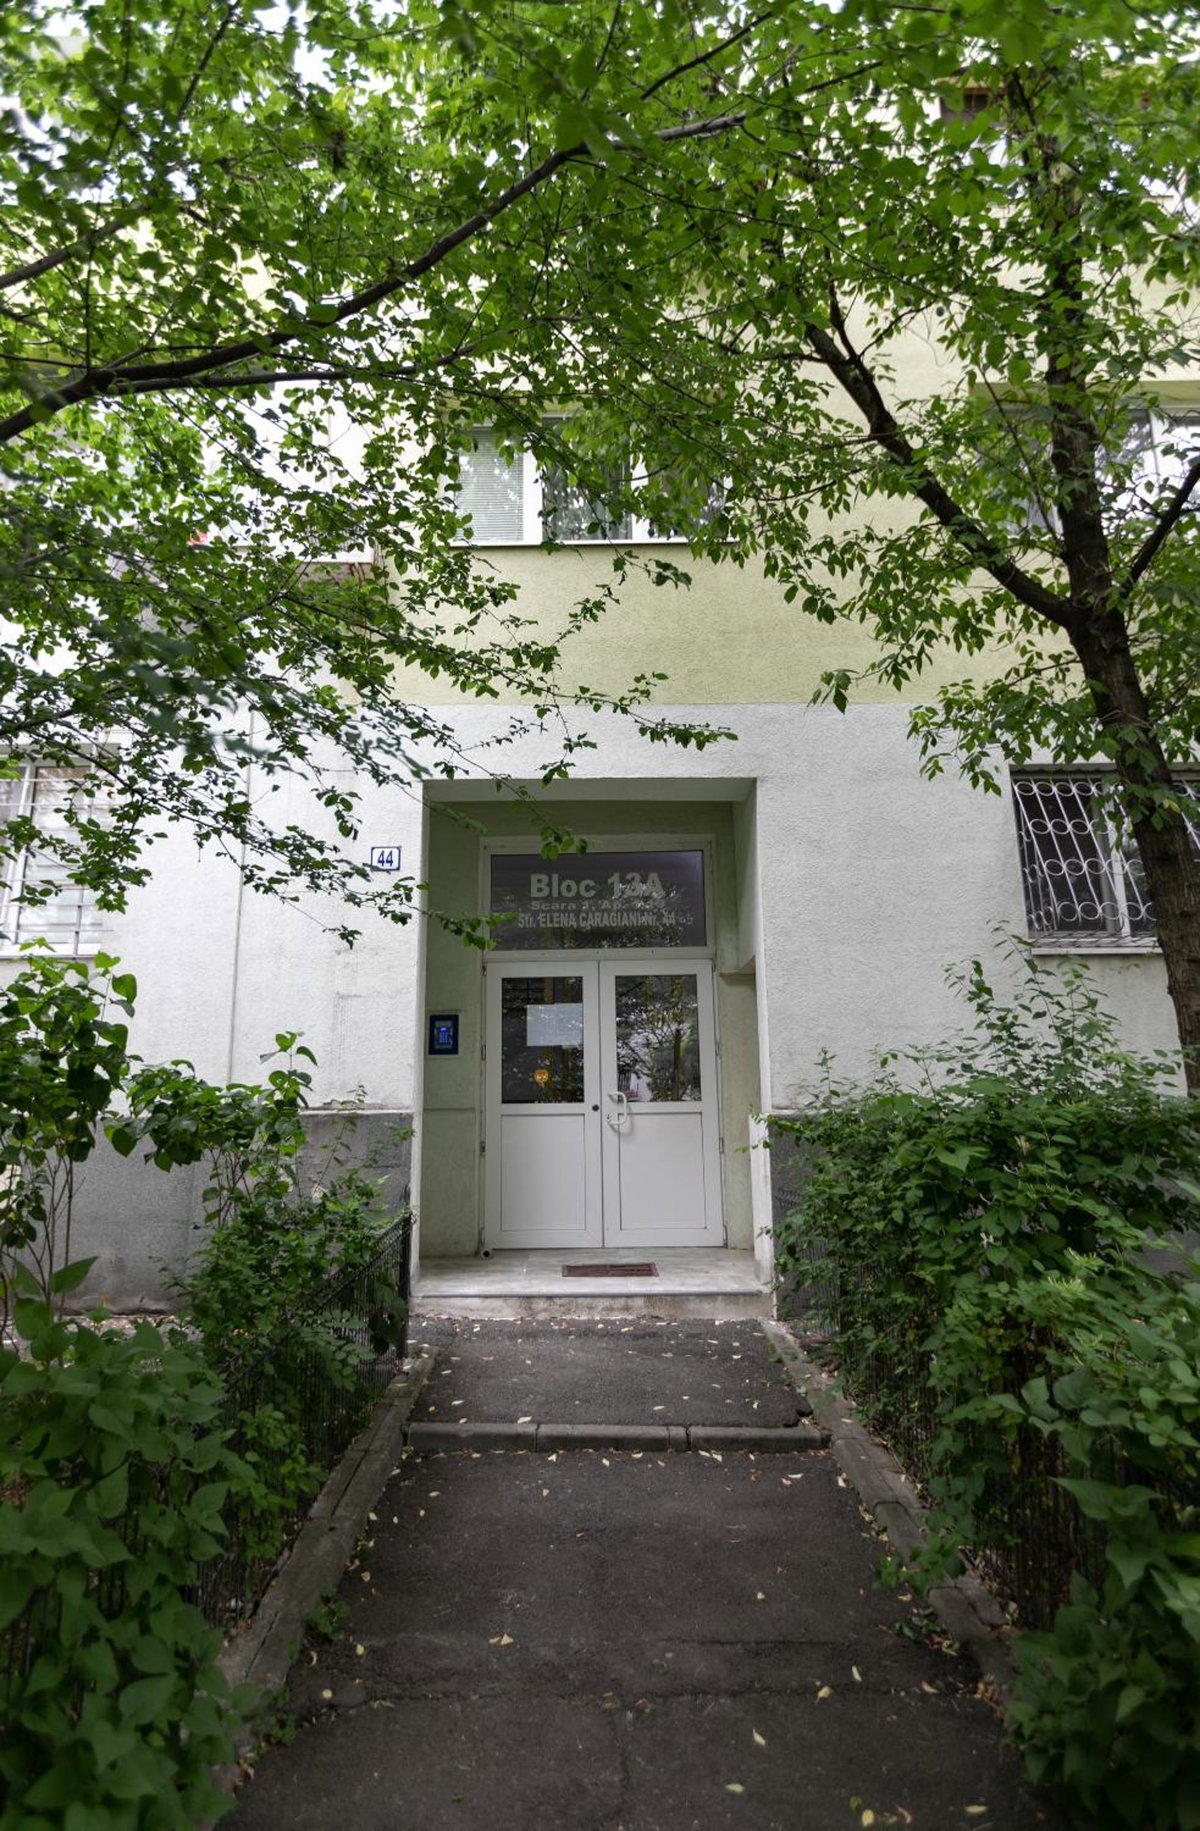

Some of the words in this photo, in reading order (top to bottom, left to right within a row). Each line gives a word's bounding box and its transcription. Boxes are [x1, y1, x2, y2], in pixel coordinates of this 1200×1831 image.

[377, 850, 394, 867] 44
[530, 873, 596, 898] Bloc
[608, 871, 664, 898] 13A
[530, 901, 577, 910] Scara
[518, 912, 536, 928] Str.
[539, 912, 577, 927] ELENA
[579, 911, 640, 927] CARAGIANI
